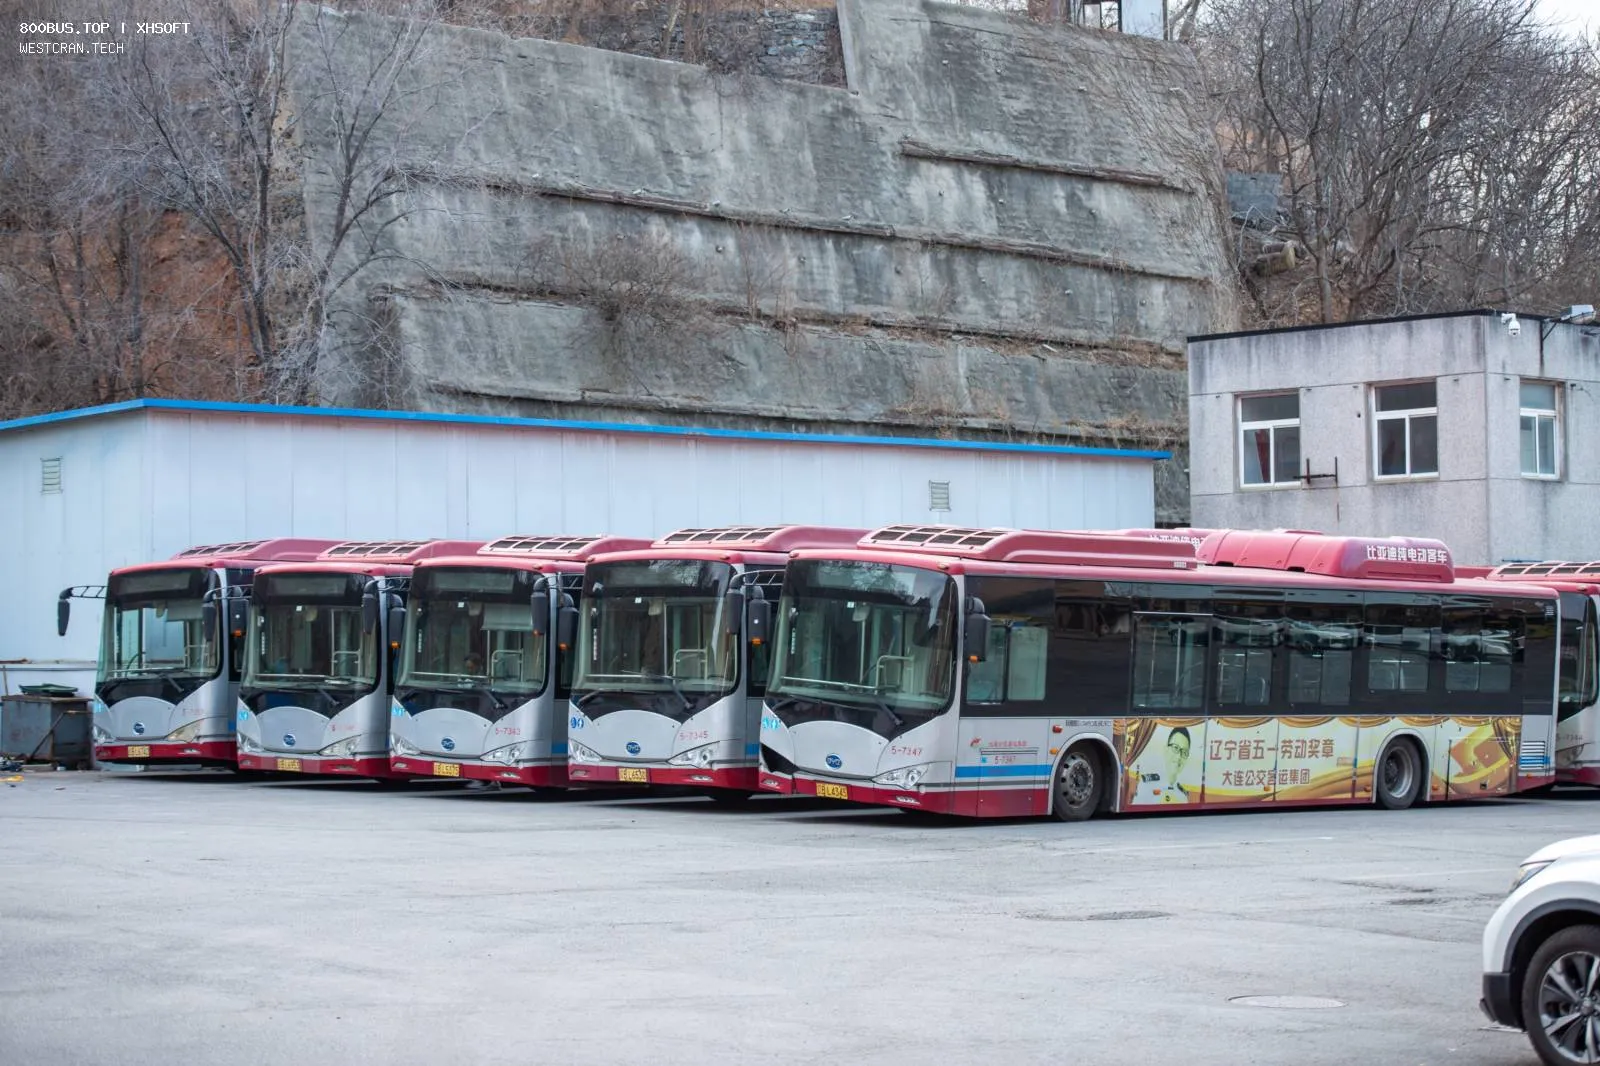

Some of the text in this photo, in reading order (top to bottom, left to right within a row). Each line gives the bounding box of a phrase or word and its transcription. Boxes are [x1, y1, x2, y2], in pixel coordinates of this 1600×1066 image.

[1366, 545, 1448, 564] 比亚迪纯电动客车
[891, 747, 923, 757] 5-7347
[1209, 739, 1335, 761] 辽宁省五一劳动奖章
[1222, 768, 1311, 786] 大连公交客运集团
